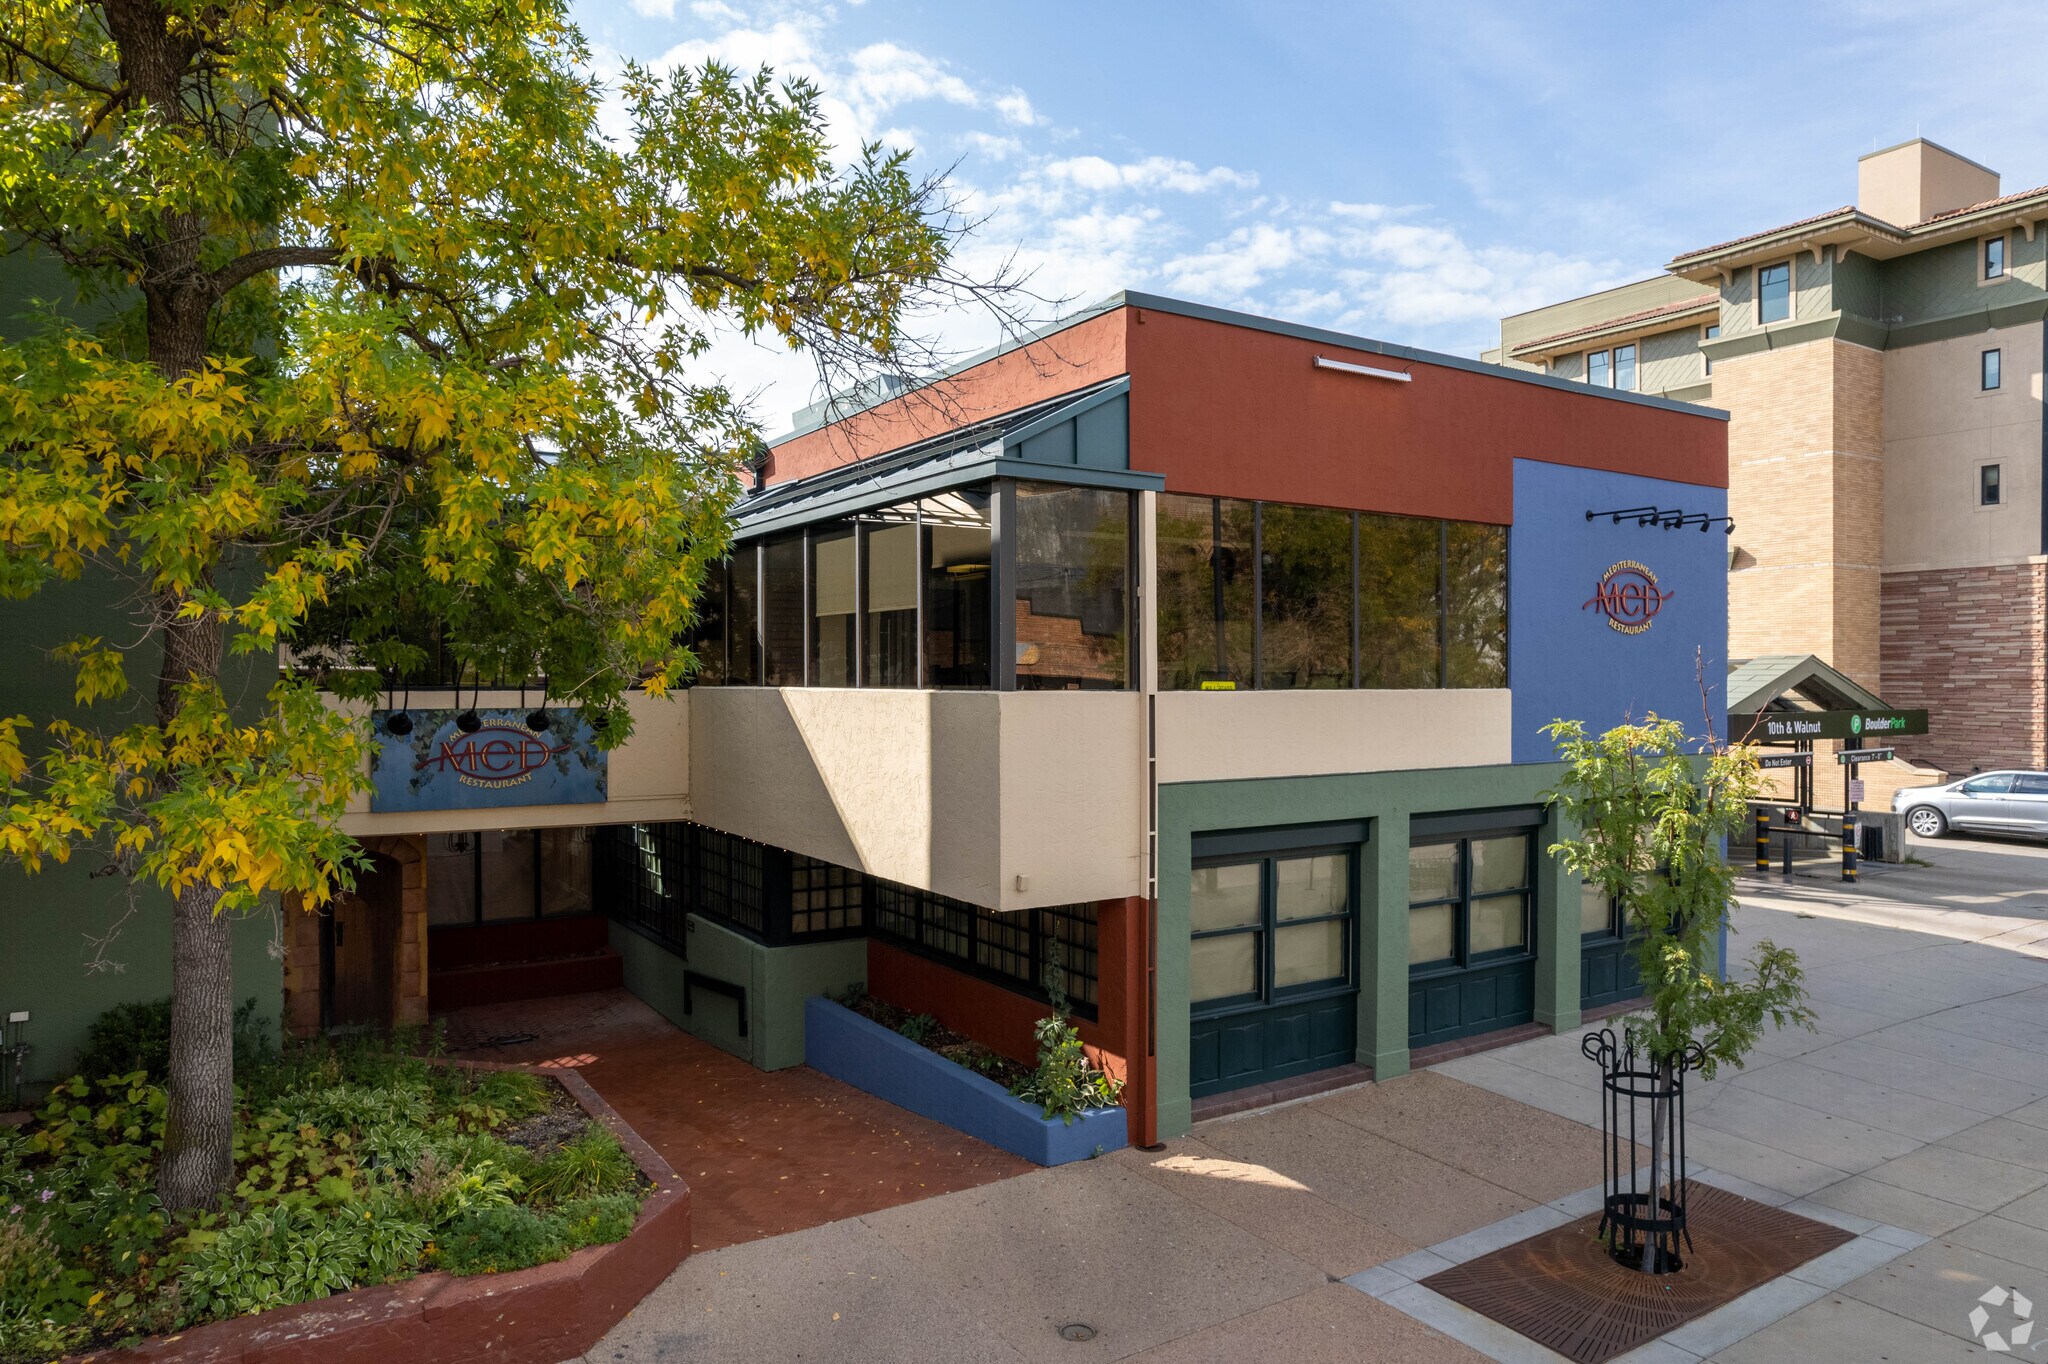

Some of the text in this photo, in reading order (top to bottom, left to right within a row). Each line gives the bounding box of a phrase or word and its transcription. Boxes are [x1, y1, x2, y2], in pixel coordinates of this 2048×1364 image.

[1603, 560, 1658, 583] MEDITERRANEAN
[1608, 618, 1653, 635] RESTAURANT
[450, 718, 542, 742] MEERRANEAN
[1768, 720, 1821, 735] 10th & Walnut
[1865, 716, 1905, 730] BoulderPark
[1765, 759, 1771, 767] Do
[1780, 758, 1792, 766] Enter
[459, 773, 532, 789] RESTAURANT
